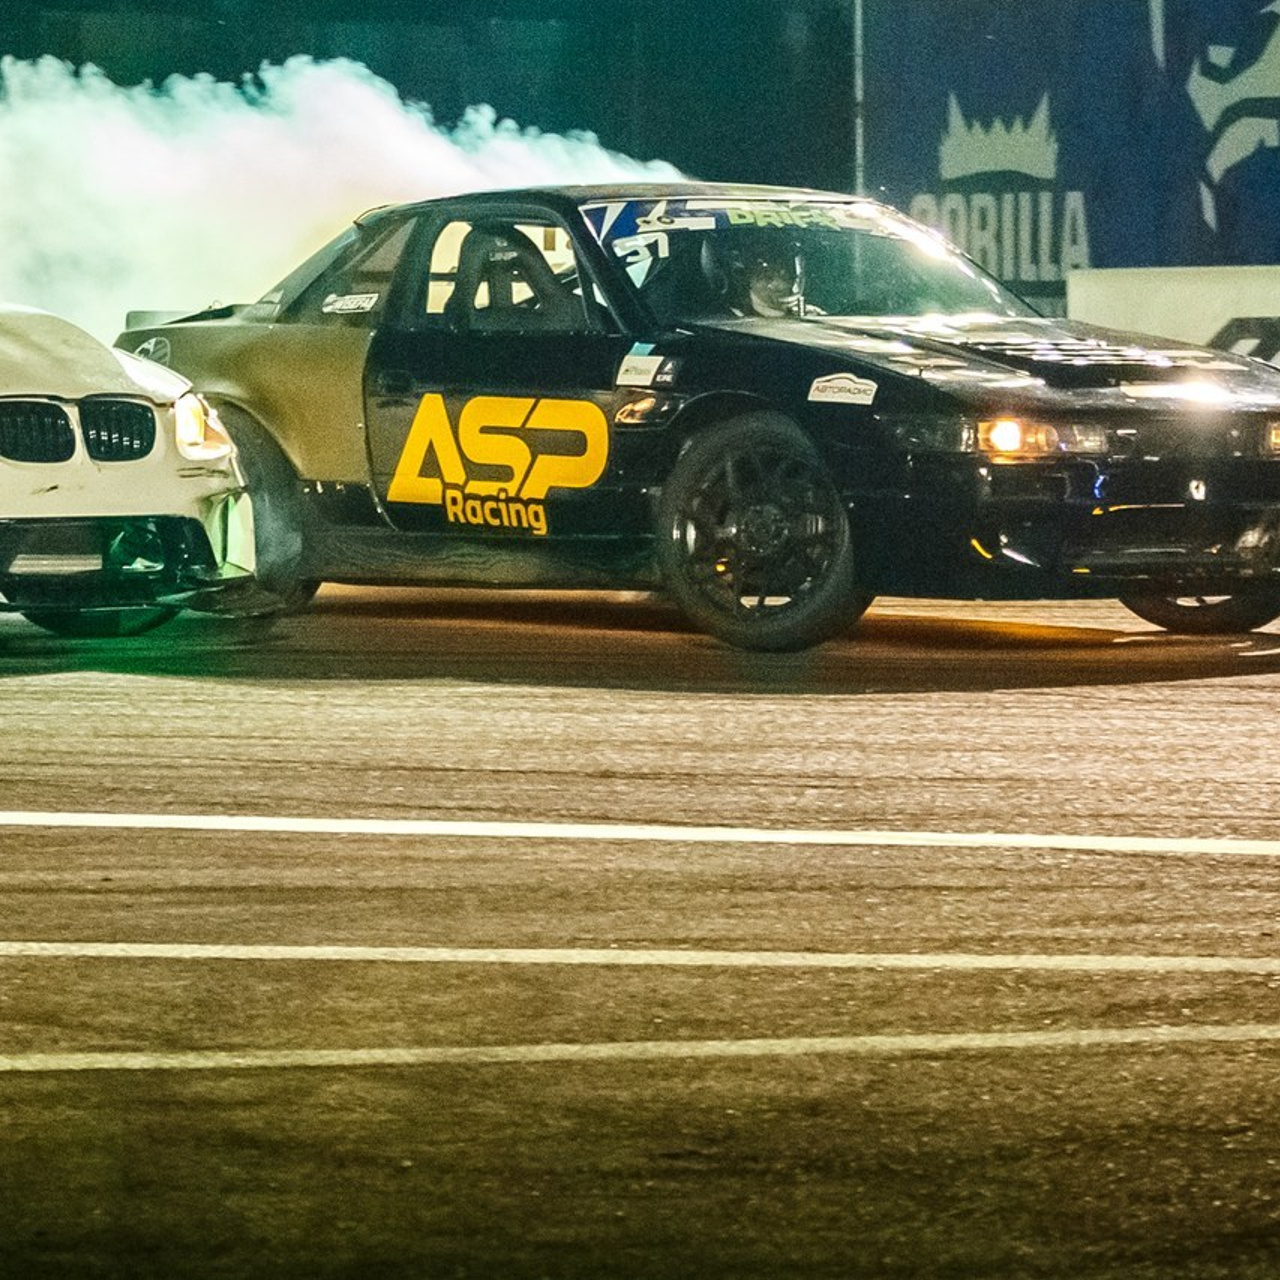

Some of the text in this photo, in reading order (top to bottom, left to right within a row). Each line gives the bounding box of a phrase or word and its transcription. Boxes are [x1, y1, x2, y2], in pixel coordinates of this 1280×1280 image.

[612, 232, 670, 263] 57
[386, 392, 610, 505] ASP
[444, 487, 549, 536] Racing
